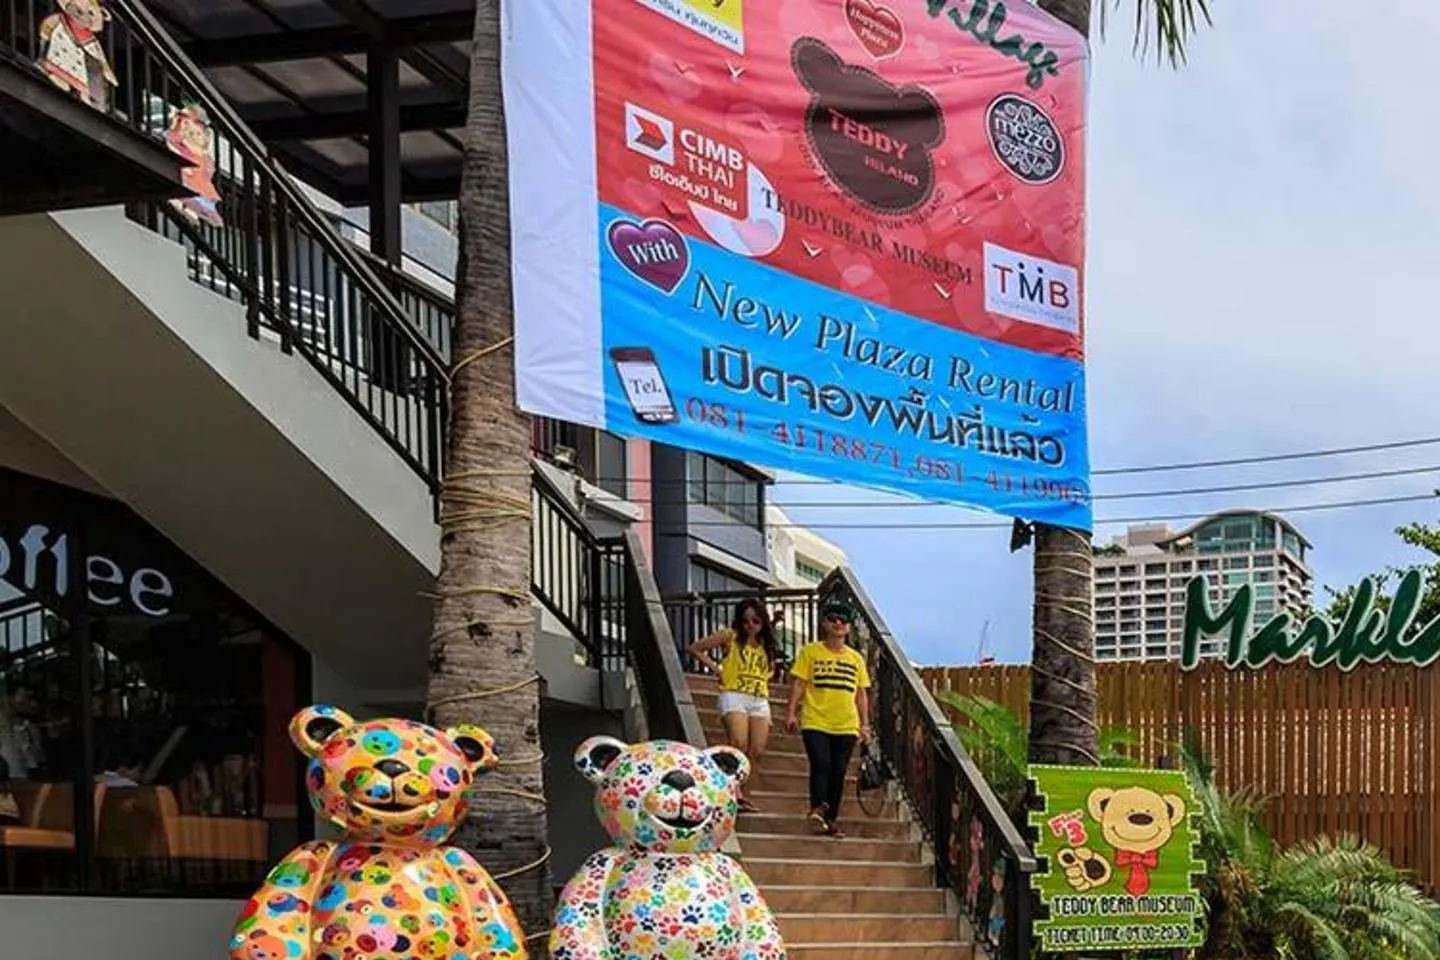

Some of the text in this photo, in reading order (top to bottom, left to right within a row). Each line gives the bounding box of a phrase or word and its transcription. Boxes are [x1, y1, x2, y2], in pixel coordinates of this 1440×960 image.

[680, 129, 744, 171] CIMB
[828, 108, 908, 160] TEDDY
[996, 117, 1057, 152] mezzo
[684, 152, 736, 189] THAI
[627, 239, 680, 266] With
[892, 241, 973, 285] MUSEUM
[993, 262, 1070, 309] TMB
[691, 272, 1078, 414] New Plaza Rental
[0, 524, 174, 616] ffee
[1054, 898, 1097, 915] TEDDY
[1101, 897, 1135, 913] BEAR
